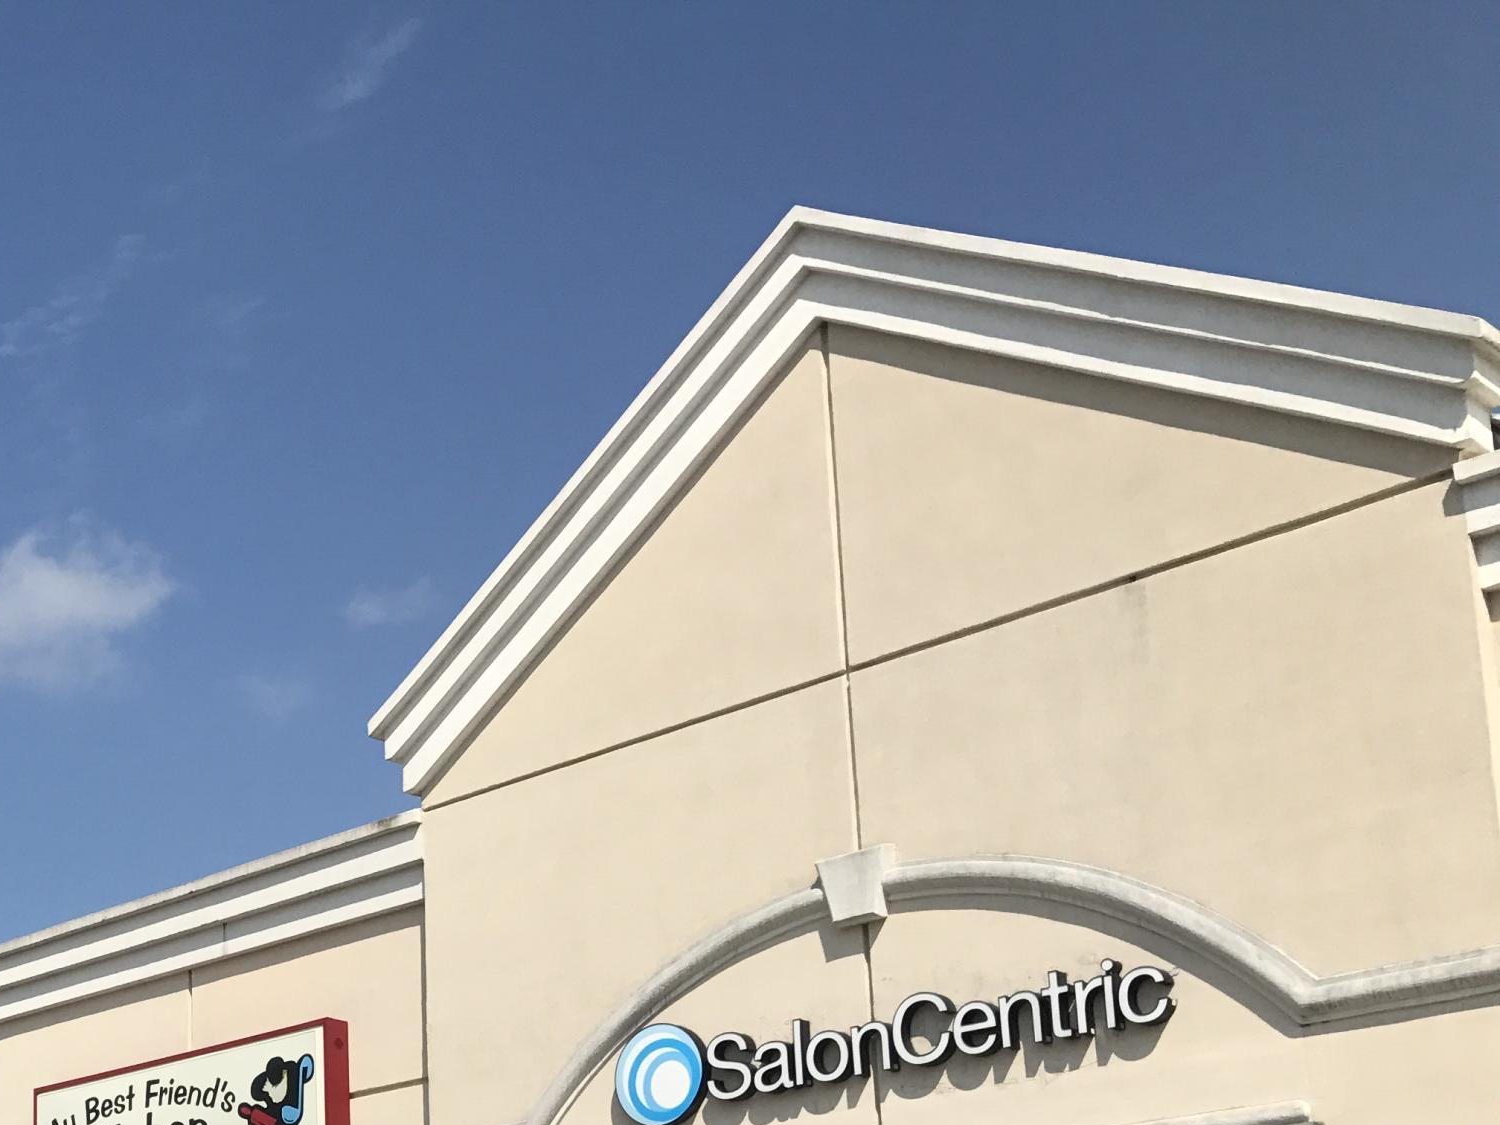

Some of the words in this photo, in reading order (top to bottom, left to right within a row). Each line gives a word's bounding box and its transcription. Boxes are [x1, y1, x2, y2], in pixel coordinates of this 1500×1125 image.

[705, 958, 1175, 1101] SalonCentric
[85, 1084, 135, 1125] Best
[144, 1077, 236, 1113] Friend's
